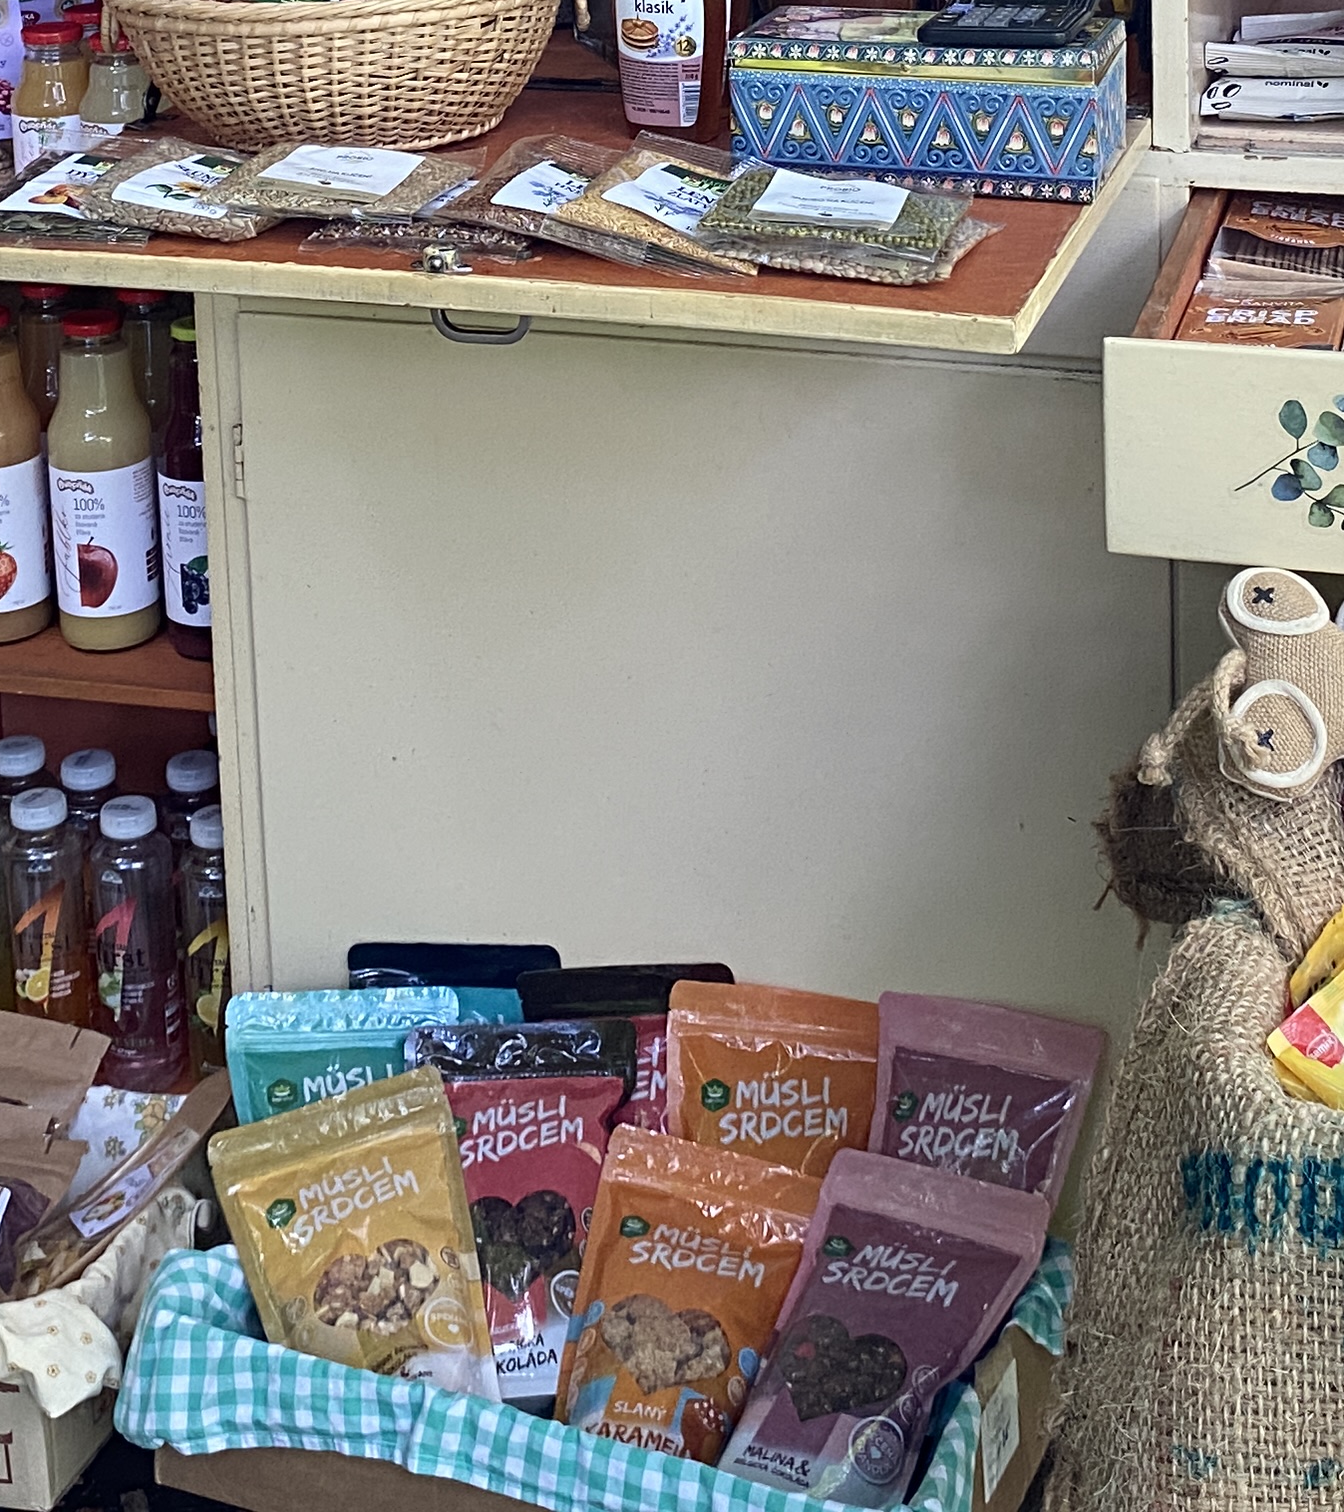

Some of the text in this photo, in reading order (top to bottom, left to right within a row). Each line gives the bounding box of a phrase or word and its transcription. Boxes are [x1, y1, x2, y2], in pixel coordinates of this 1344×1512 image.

[677, 40, 690, 51] 12
[73, 497, 106, 513] 100%
[734, 1072, 830, 1108] MÜSLI
[919, 1086, 1012, 1123] MÜSLI
[472, 1094, 566, 1135] MÜSLI
[718, 1108, 848, 1145] SRDCEM
[458, 1117, 584, 1169] SRDCEM
[898, 1126, 1019, 1161] SRDCEM
[298, 1156, 393, 1209] MÜSLI
[290, 1170, 420, 1246] SRDCEM
[652, 1224, 751, 1258] MÜSLI
[853, 1242, 956, 1276] MÜSLI
[629, 1240, 765, 1287] SRDCEM
[822, 1261, 959, 1307] SRDCEM
[613, 1400, 668, 1422] SLANÝ
